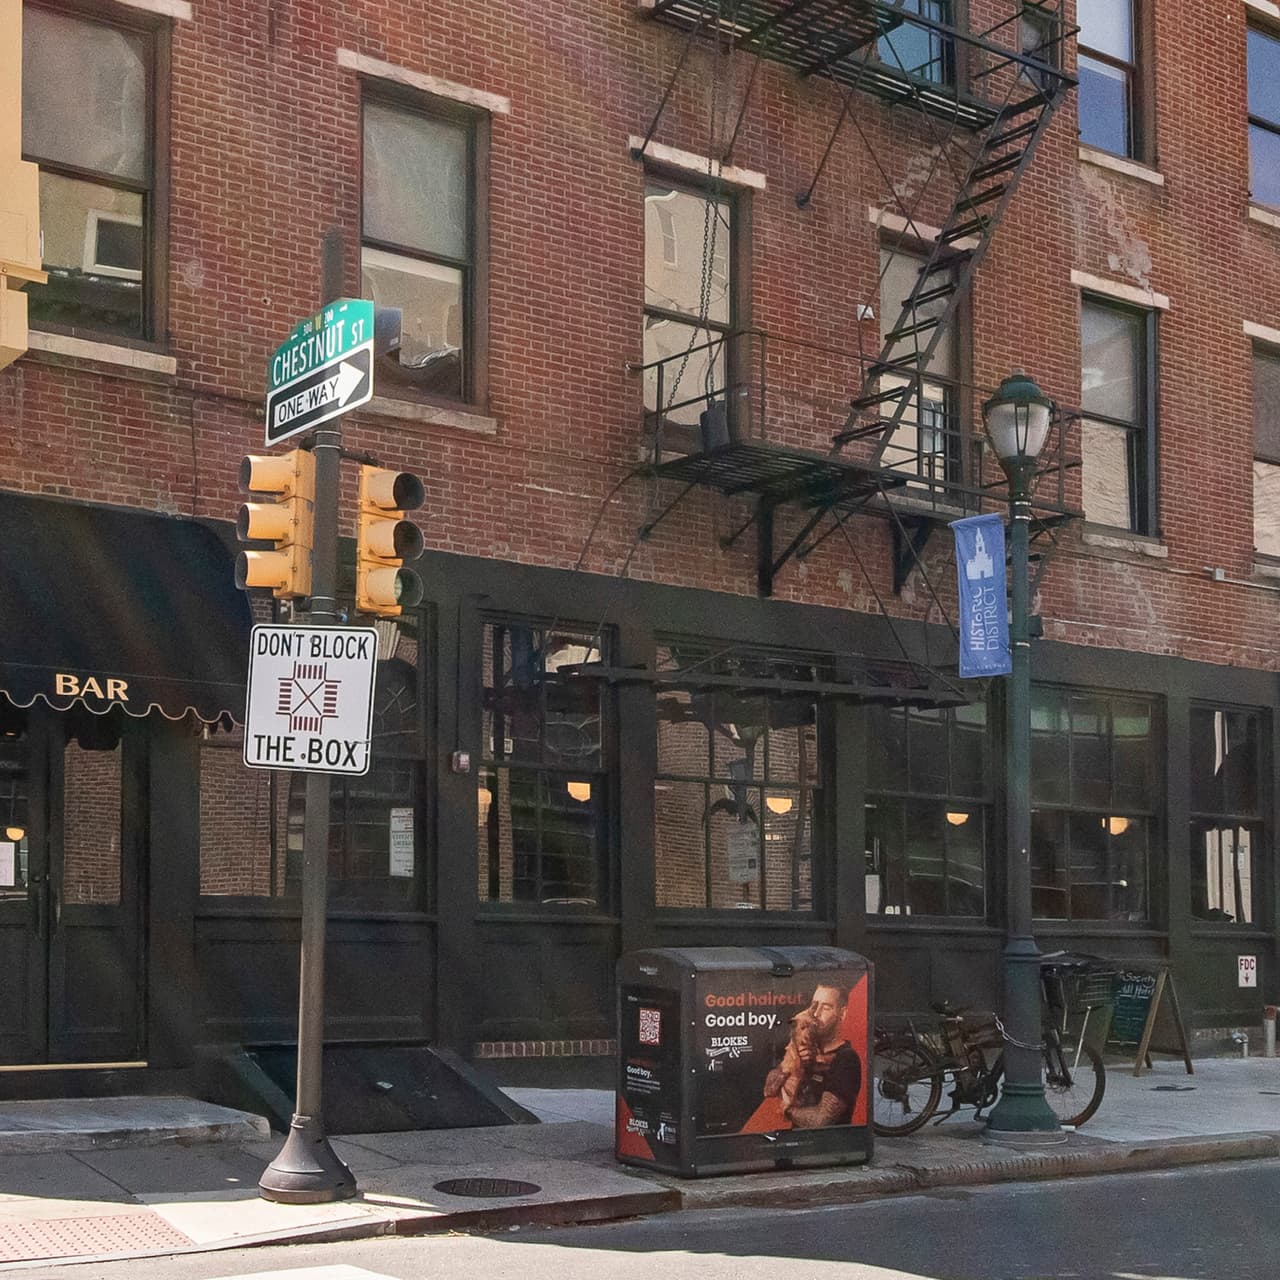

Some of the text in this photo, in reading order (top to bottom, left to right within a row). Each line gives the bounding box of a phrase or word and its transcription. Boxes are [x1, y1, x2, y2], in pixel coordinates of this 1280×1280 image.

[273, 319, 364, 385] CHESTNUT ST
[278, 377, 339, 422] ONE WAY
[970, 586, 985, 651] HISTORIC
[984, 586, 999, 650] DISTRICT
[257, 632, 369, 660] DON'T BLOCK
[55, 673, 129, 701] BAR
[253, 734, 360, 767] THE BOX
[1239, 958, 1255, 970] FDC
[705, 993, 745, 1008] Good
[705, 1012, 781, 1029] Good boy.
[711, 1036, 748, 1047] BLOKES
